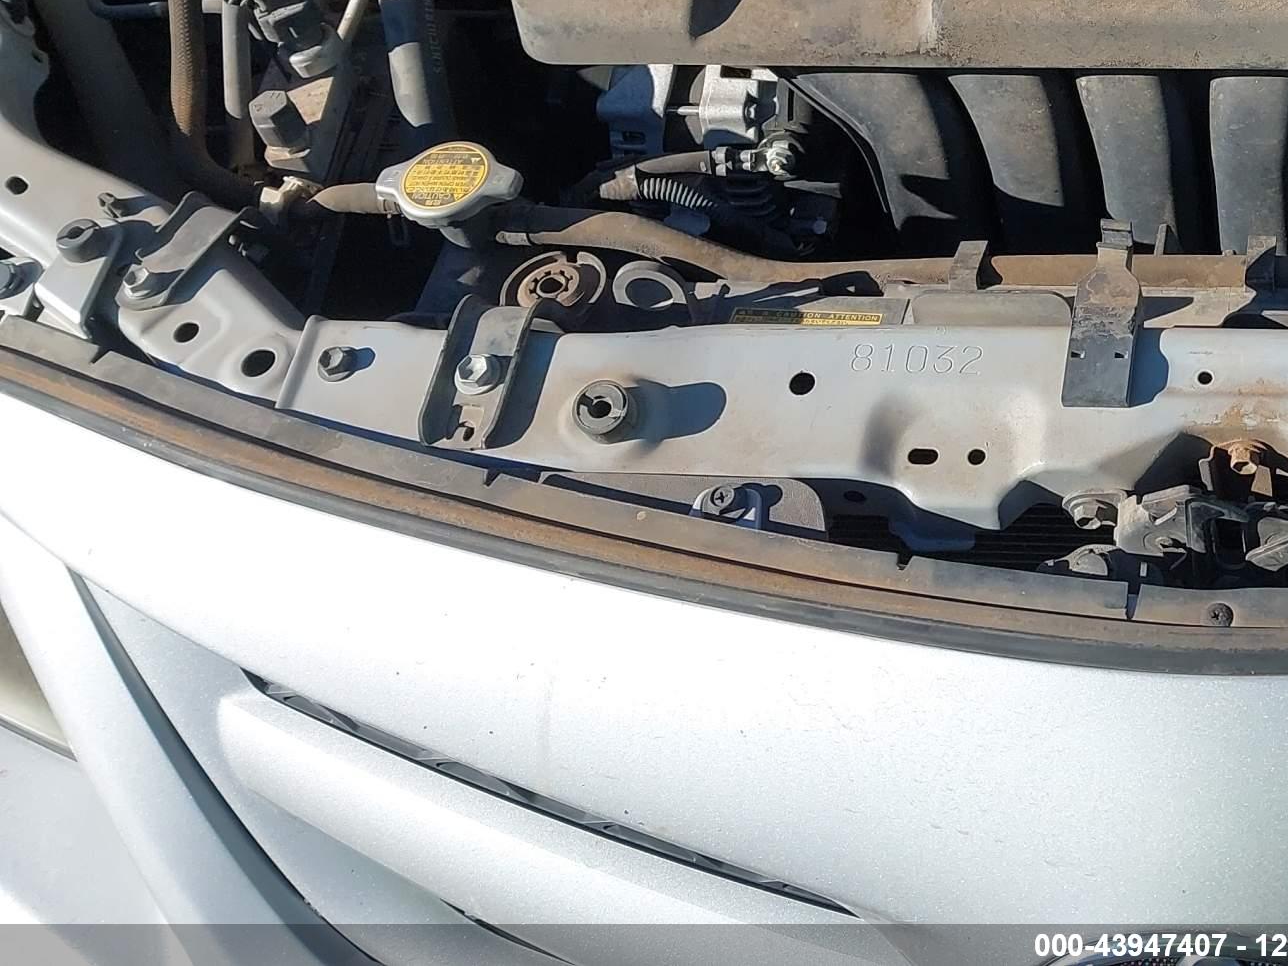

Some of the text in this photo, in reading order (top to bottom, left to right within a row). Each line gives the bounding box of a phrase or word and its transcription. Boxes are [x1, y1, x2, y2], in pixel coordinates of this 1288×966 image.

[776, 310, 821, 319] CAUTION
[830, 314, 877, 322] ATTENTION
[850, 343, 984, 375] 81032
